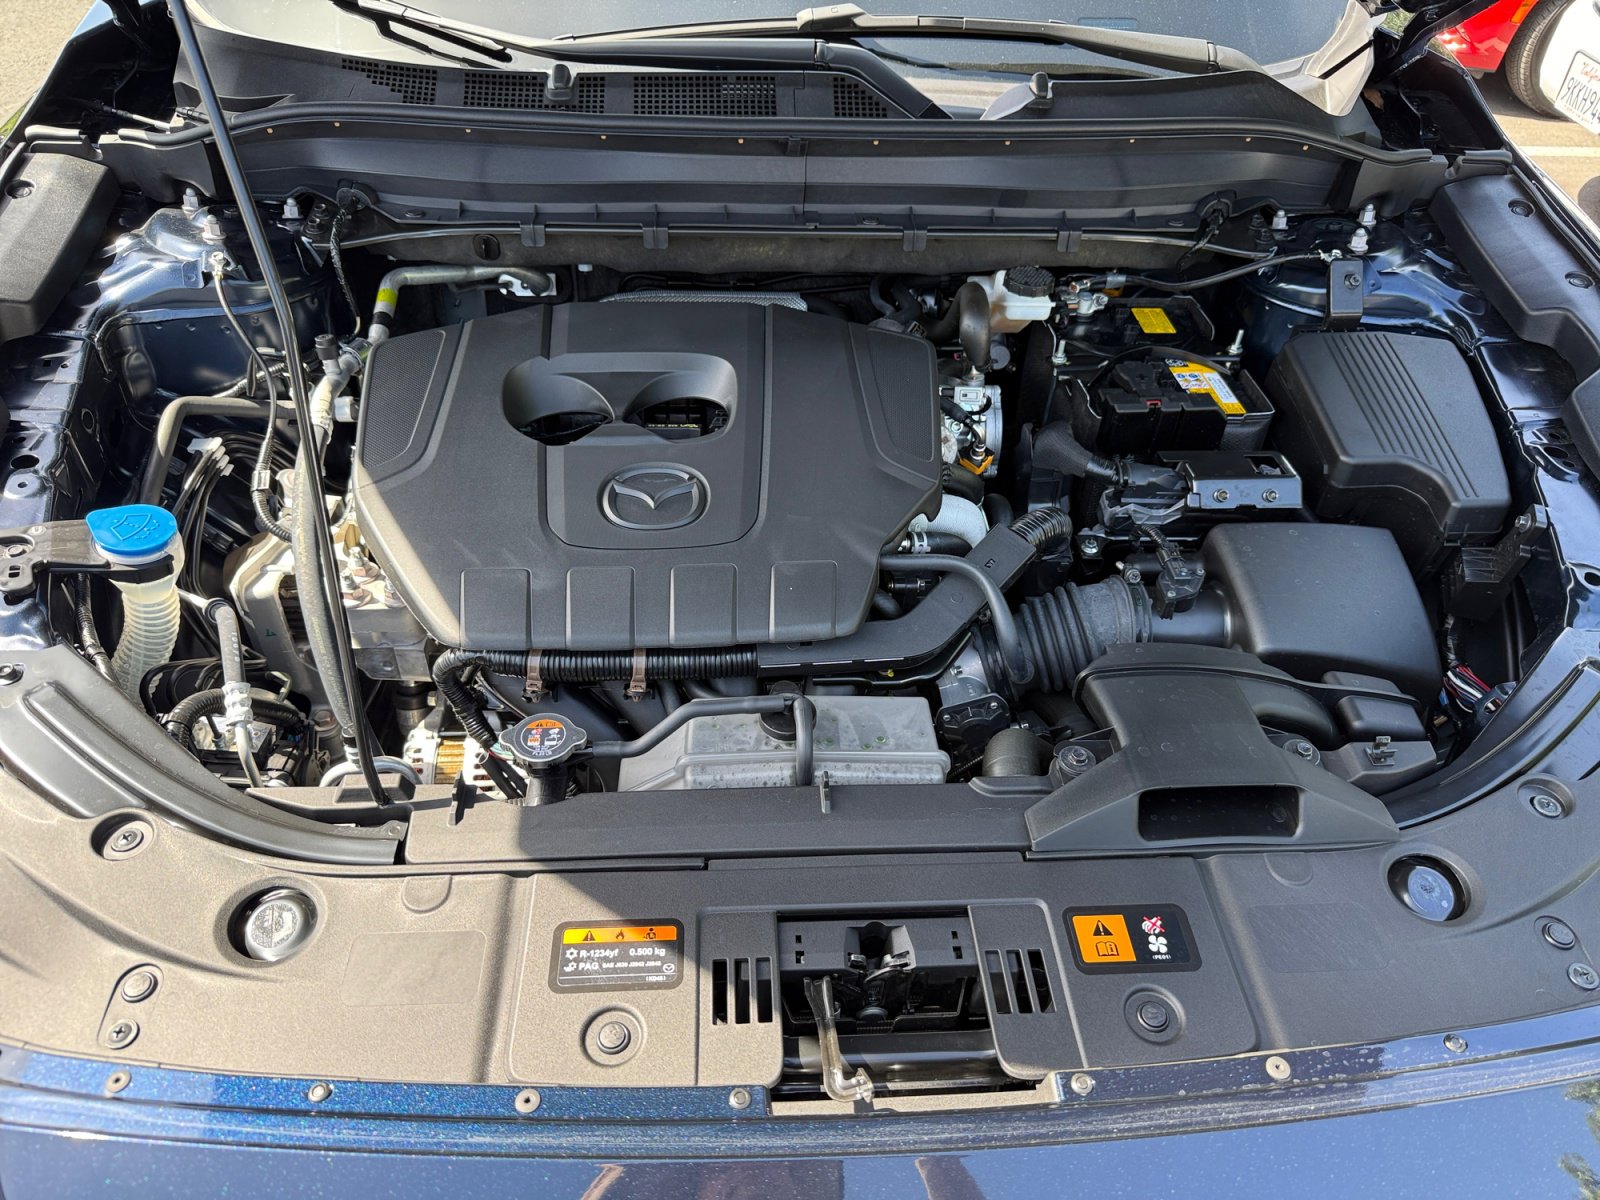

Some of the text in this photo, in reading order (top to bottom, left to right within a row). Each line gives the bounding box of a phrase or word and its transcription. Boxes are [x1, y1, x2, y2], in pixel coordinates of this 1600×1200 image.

[580, 947, 665, 958] R-1234yf 0.500 kg
[579, 962, 599, 970] PAG
